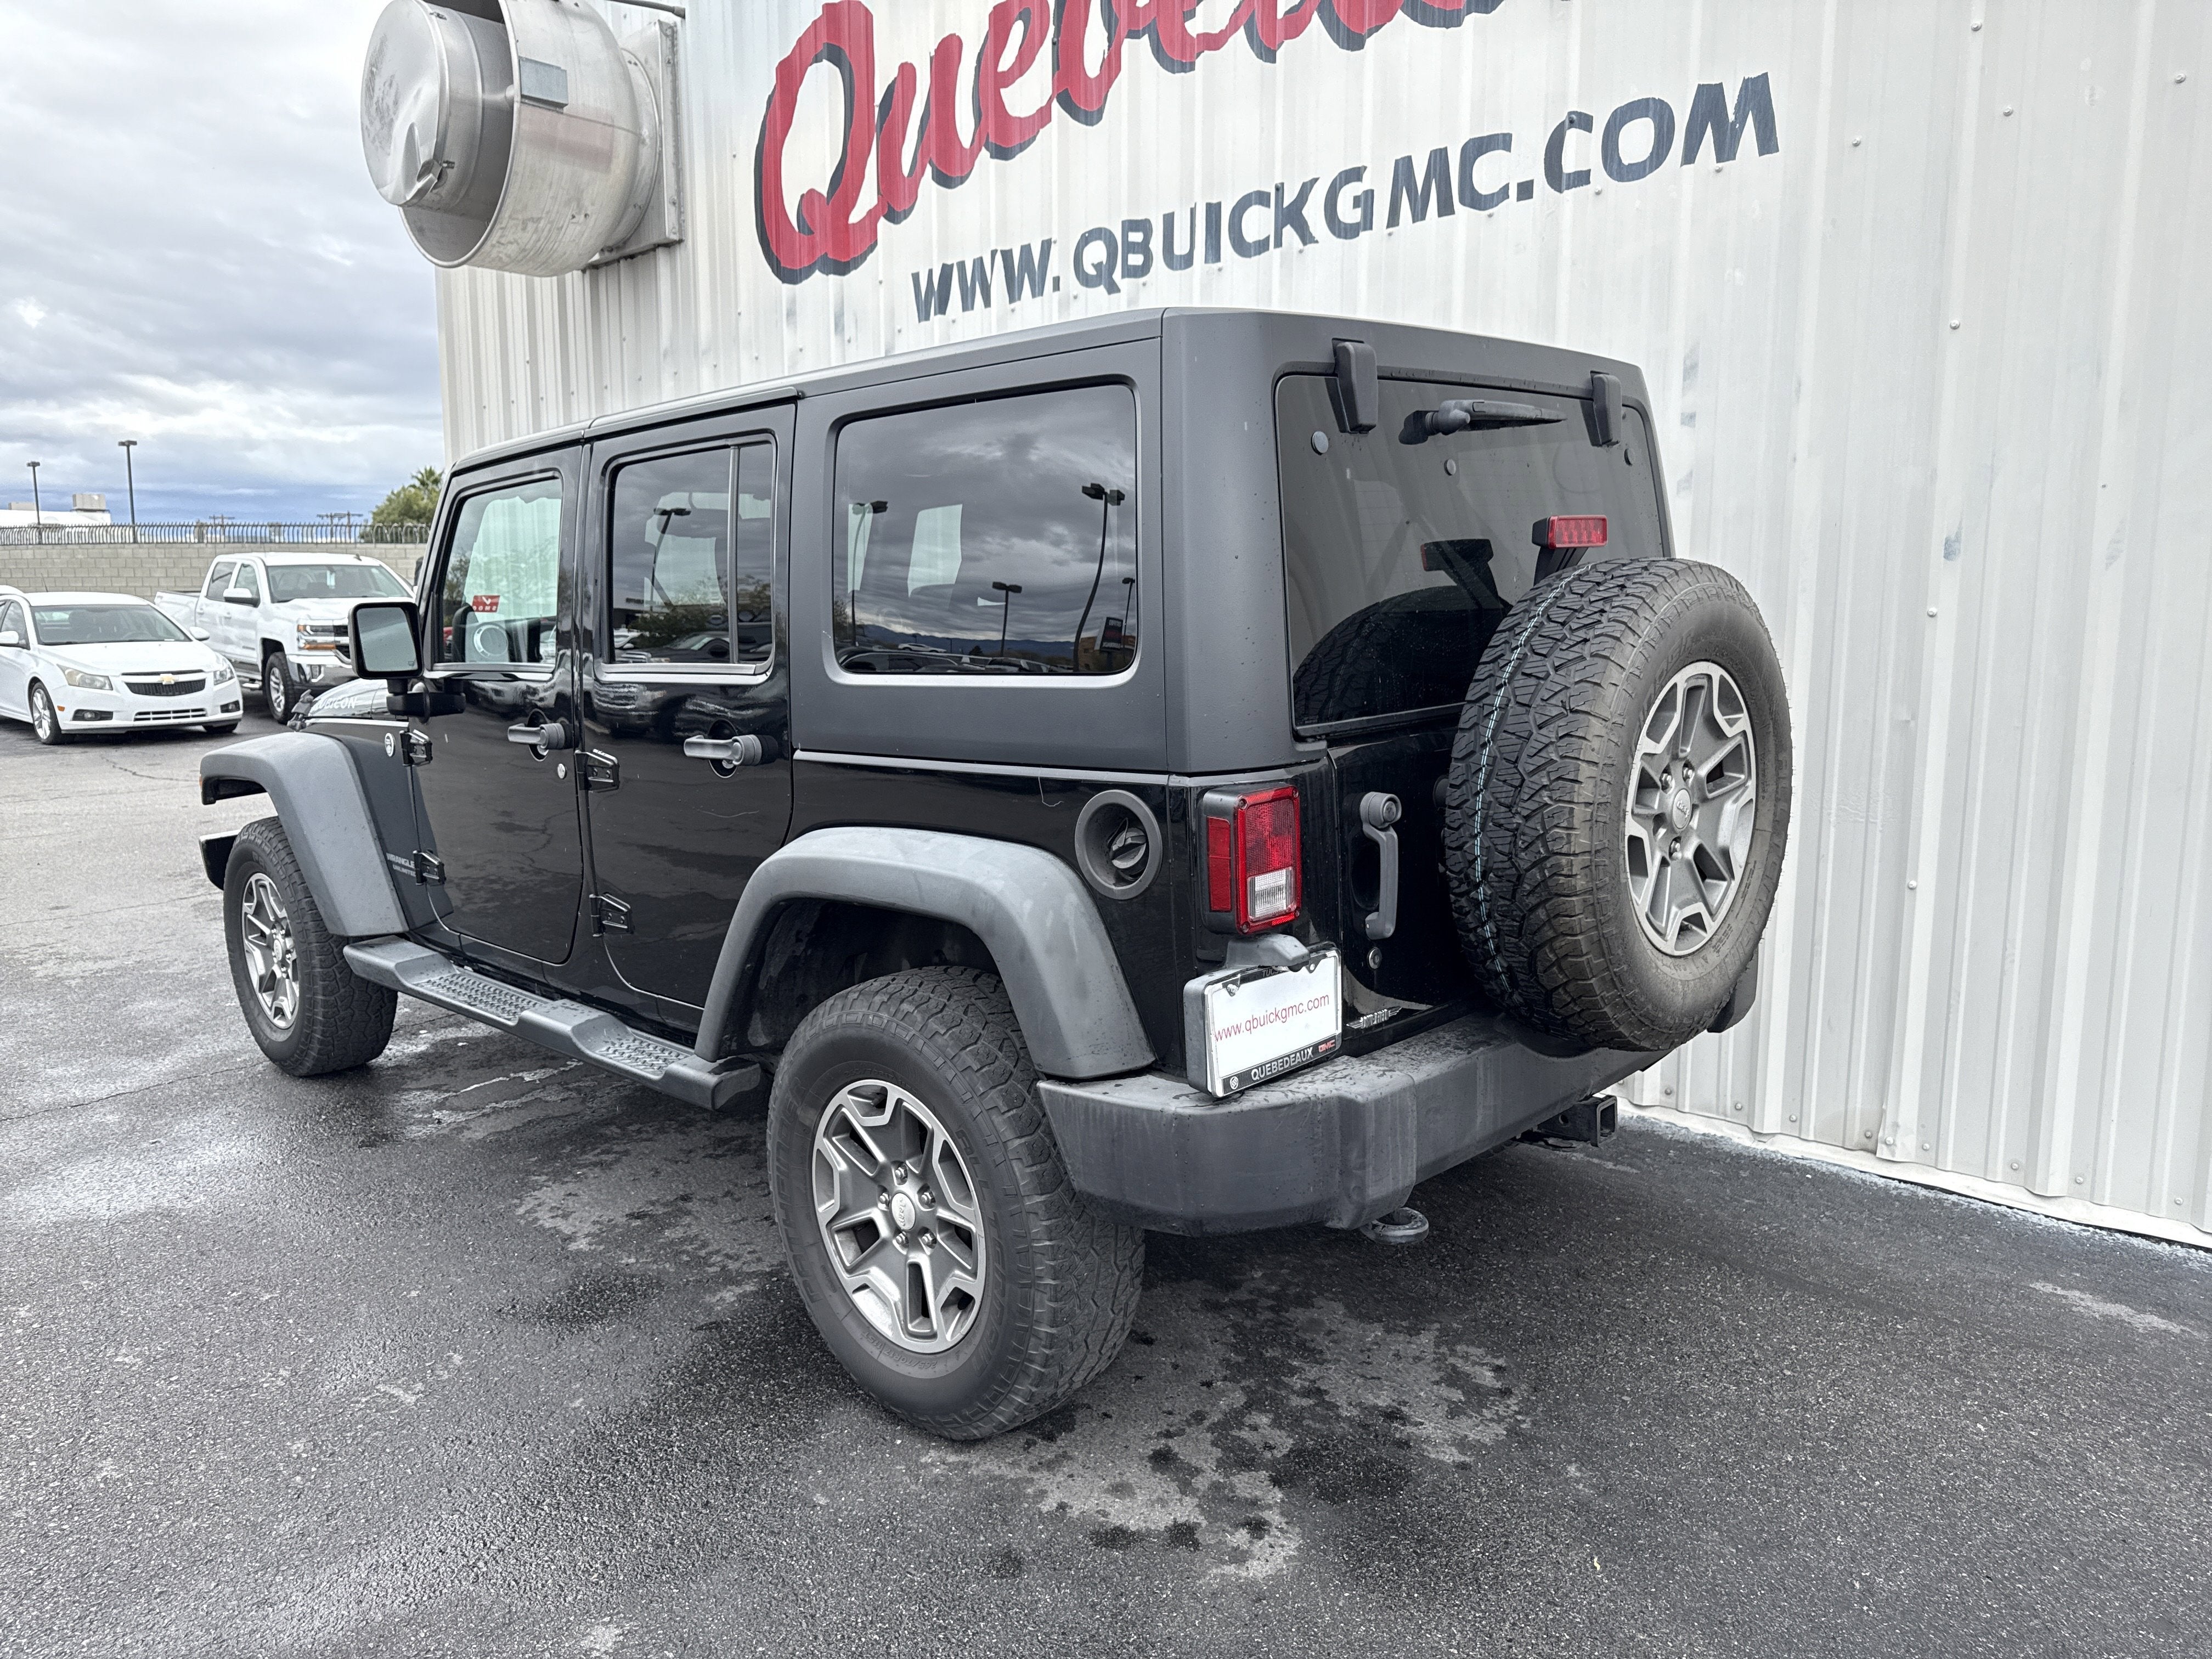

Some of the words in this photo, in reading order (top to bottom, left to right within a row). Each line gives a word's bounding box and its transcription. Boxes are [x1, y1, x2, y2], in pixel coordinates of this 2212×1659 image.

[911, 72, 1779, 323] WWW.QBUICKGMC.COM
[386, 852, 415, 870] WRANGLE
[392, 864, 416, 877] UNLIMITE
[1215, 994, 1329, 1042] www.qbuickgmc.com
[1251, 1047, 1313, 1081] QUEBEDEAUX
[1318, 1039, 1335, 1052] GMC
